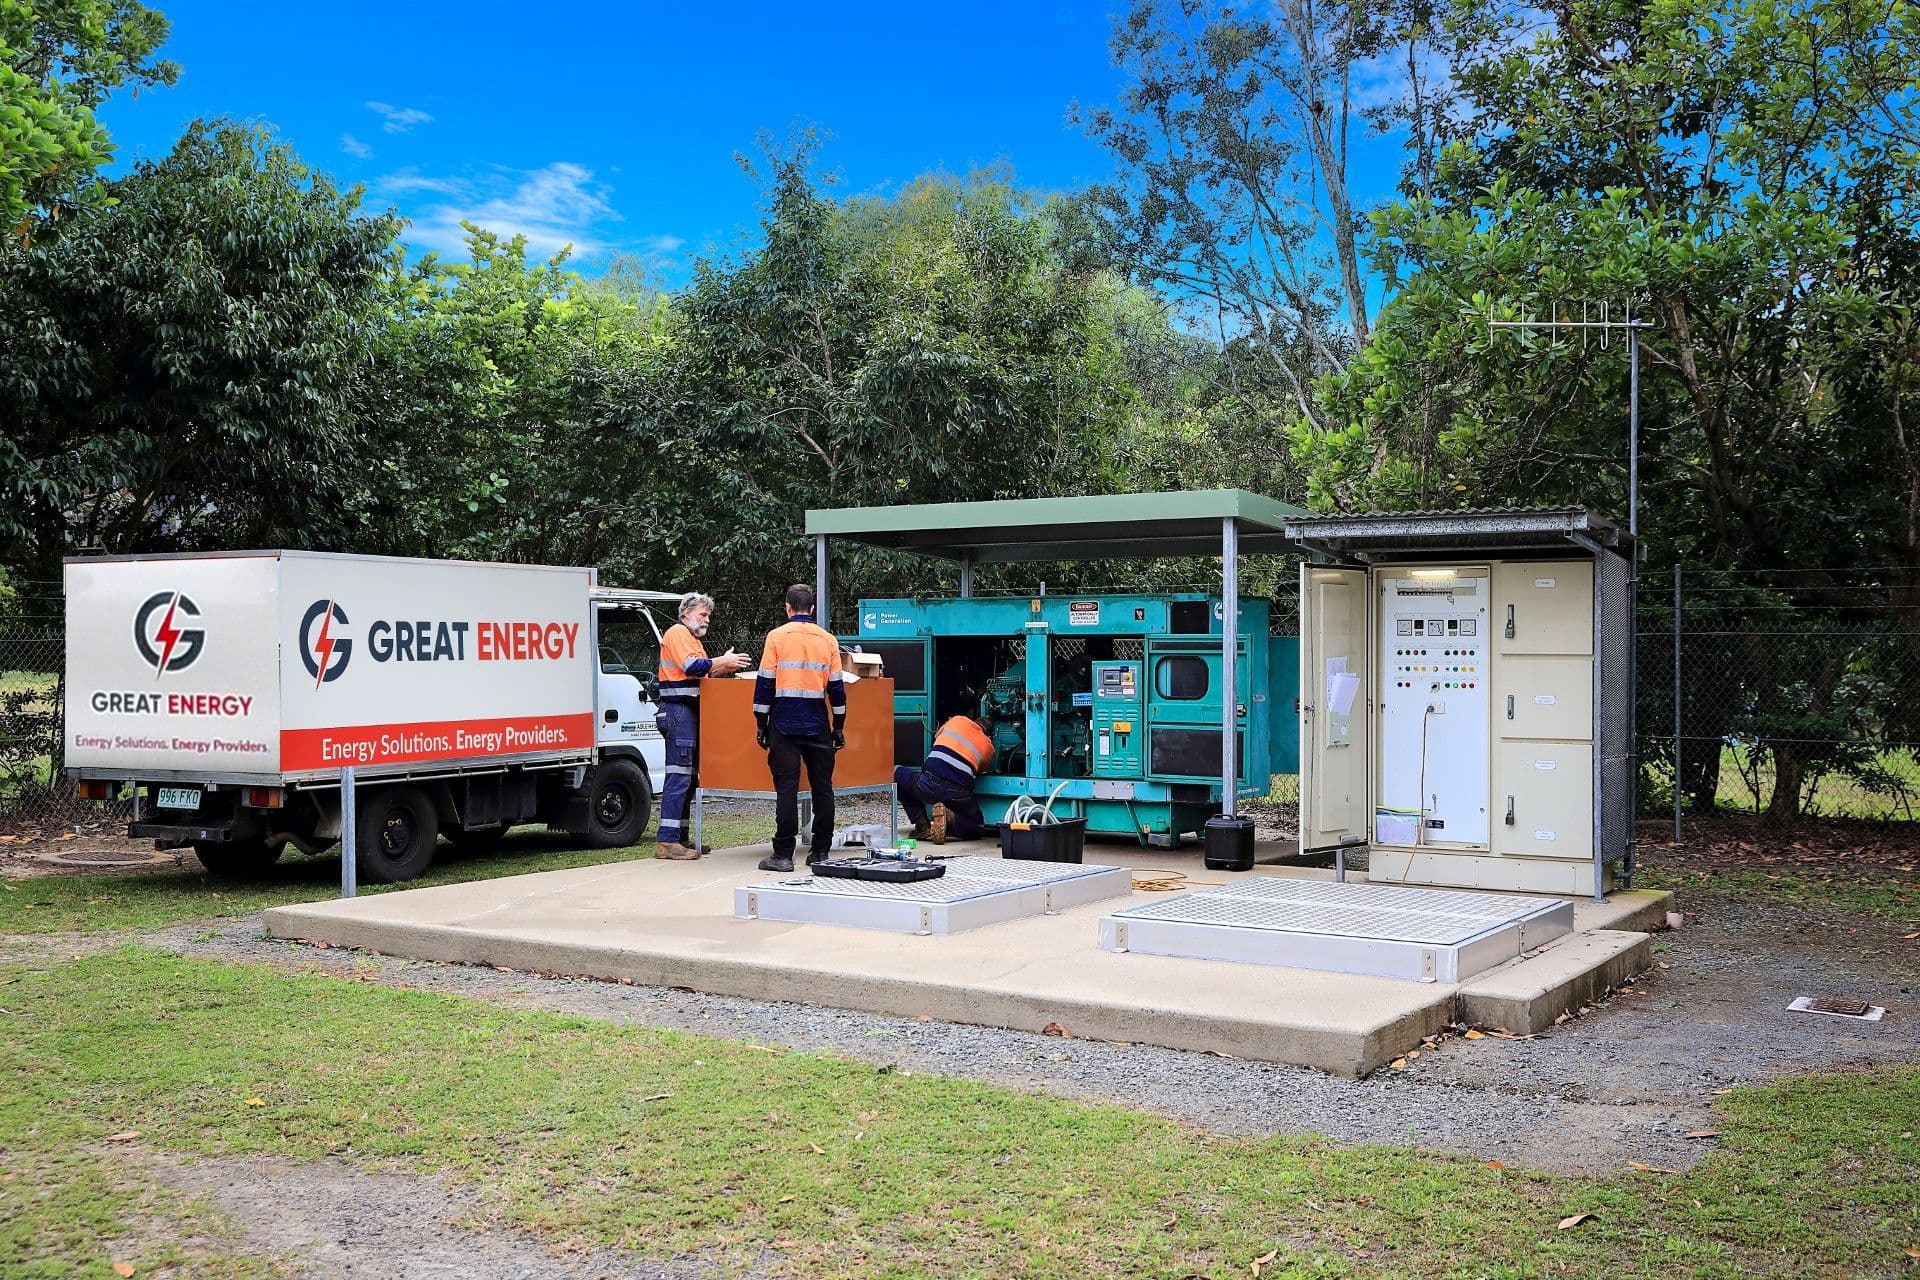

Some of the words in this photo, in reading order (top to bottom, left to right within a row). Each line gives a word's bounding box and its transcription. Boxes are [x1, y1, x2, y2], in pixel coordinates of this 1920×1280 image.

[368, 620, 469, 662] GREAT
[477, 622, 580, 660] ENERGY
[91, 692, 162, 714] GREAT
[168, 694, 253, 716] ENERGY
[75, 735, 112, 750] Energy
[115, 736, 169, 750] Solutions.
[172, 738, 211, 753] Energy
[213, 739, 271, 753] Providers.
[322, 738, 377, 762] Energy
[381, 732, 453, 756] Solutions.
[456, 729, 502, 752] Energy
[505, 725, 568, 746] Providers.
[160, 790, 176, 803] 996
